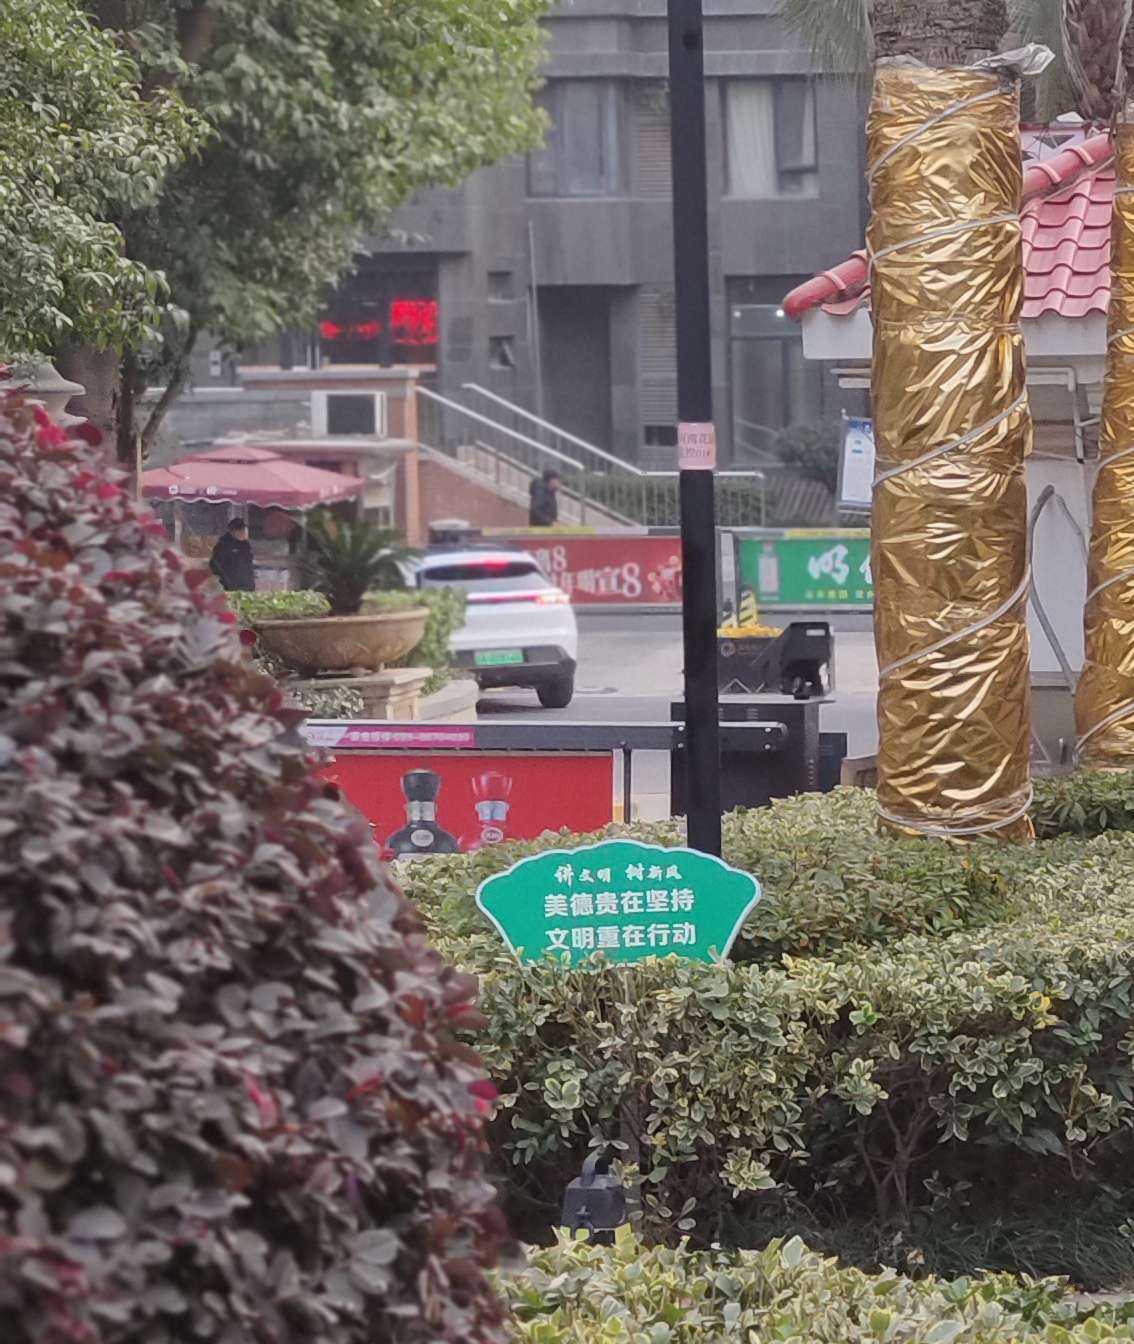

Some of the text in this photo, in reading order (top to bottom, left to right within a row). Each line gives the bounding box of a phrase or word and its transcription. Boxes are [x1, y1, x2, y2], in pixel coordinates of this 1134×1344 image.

[553, 862, 683, 887] 讲文明 树新风
[543, 887, 696, 919] 美德贵在坚持
[544, 921, 697, 951] 文明重在行动
